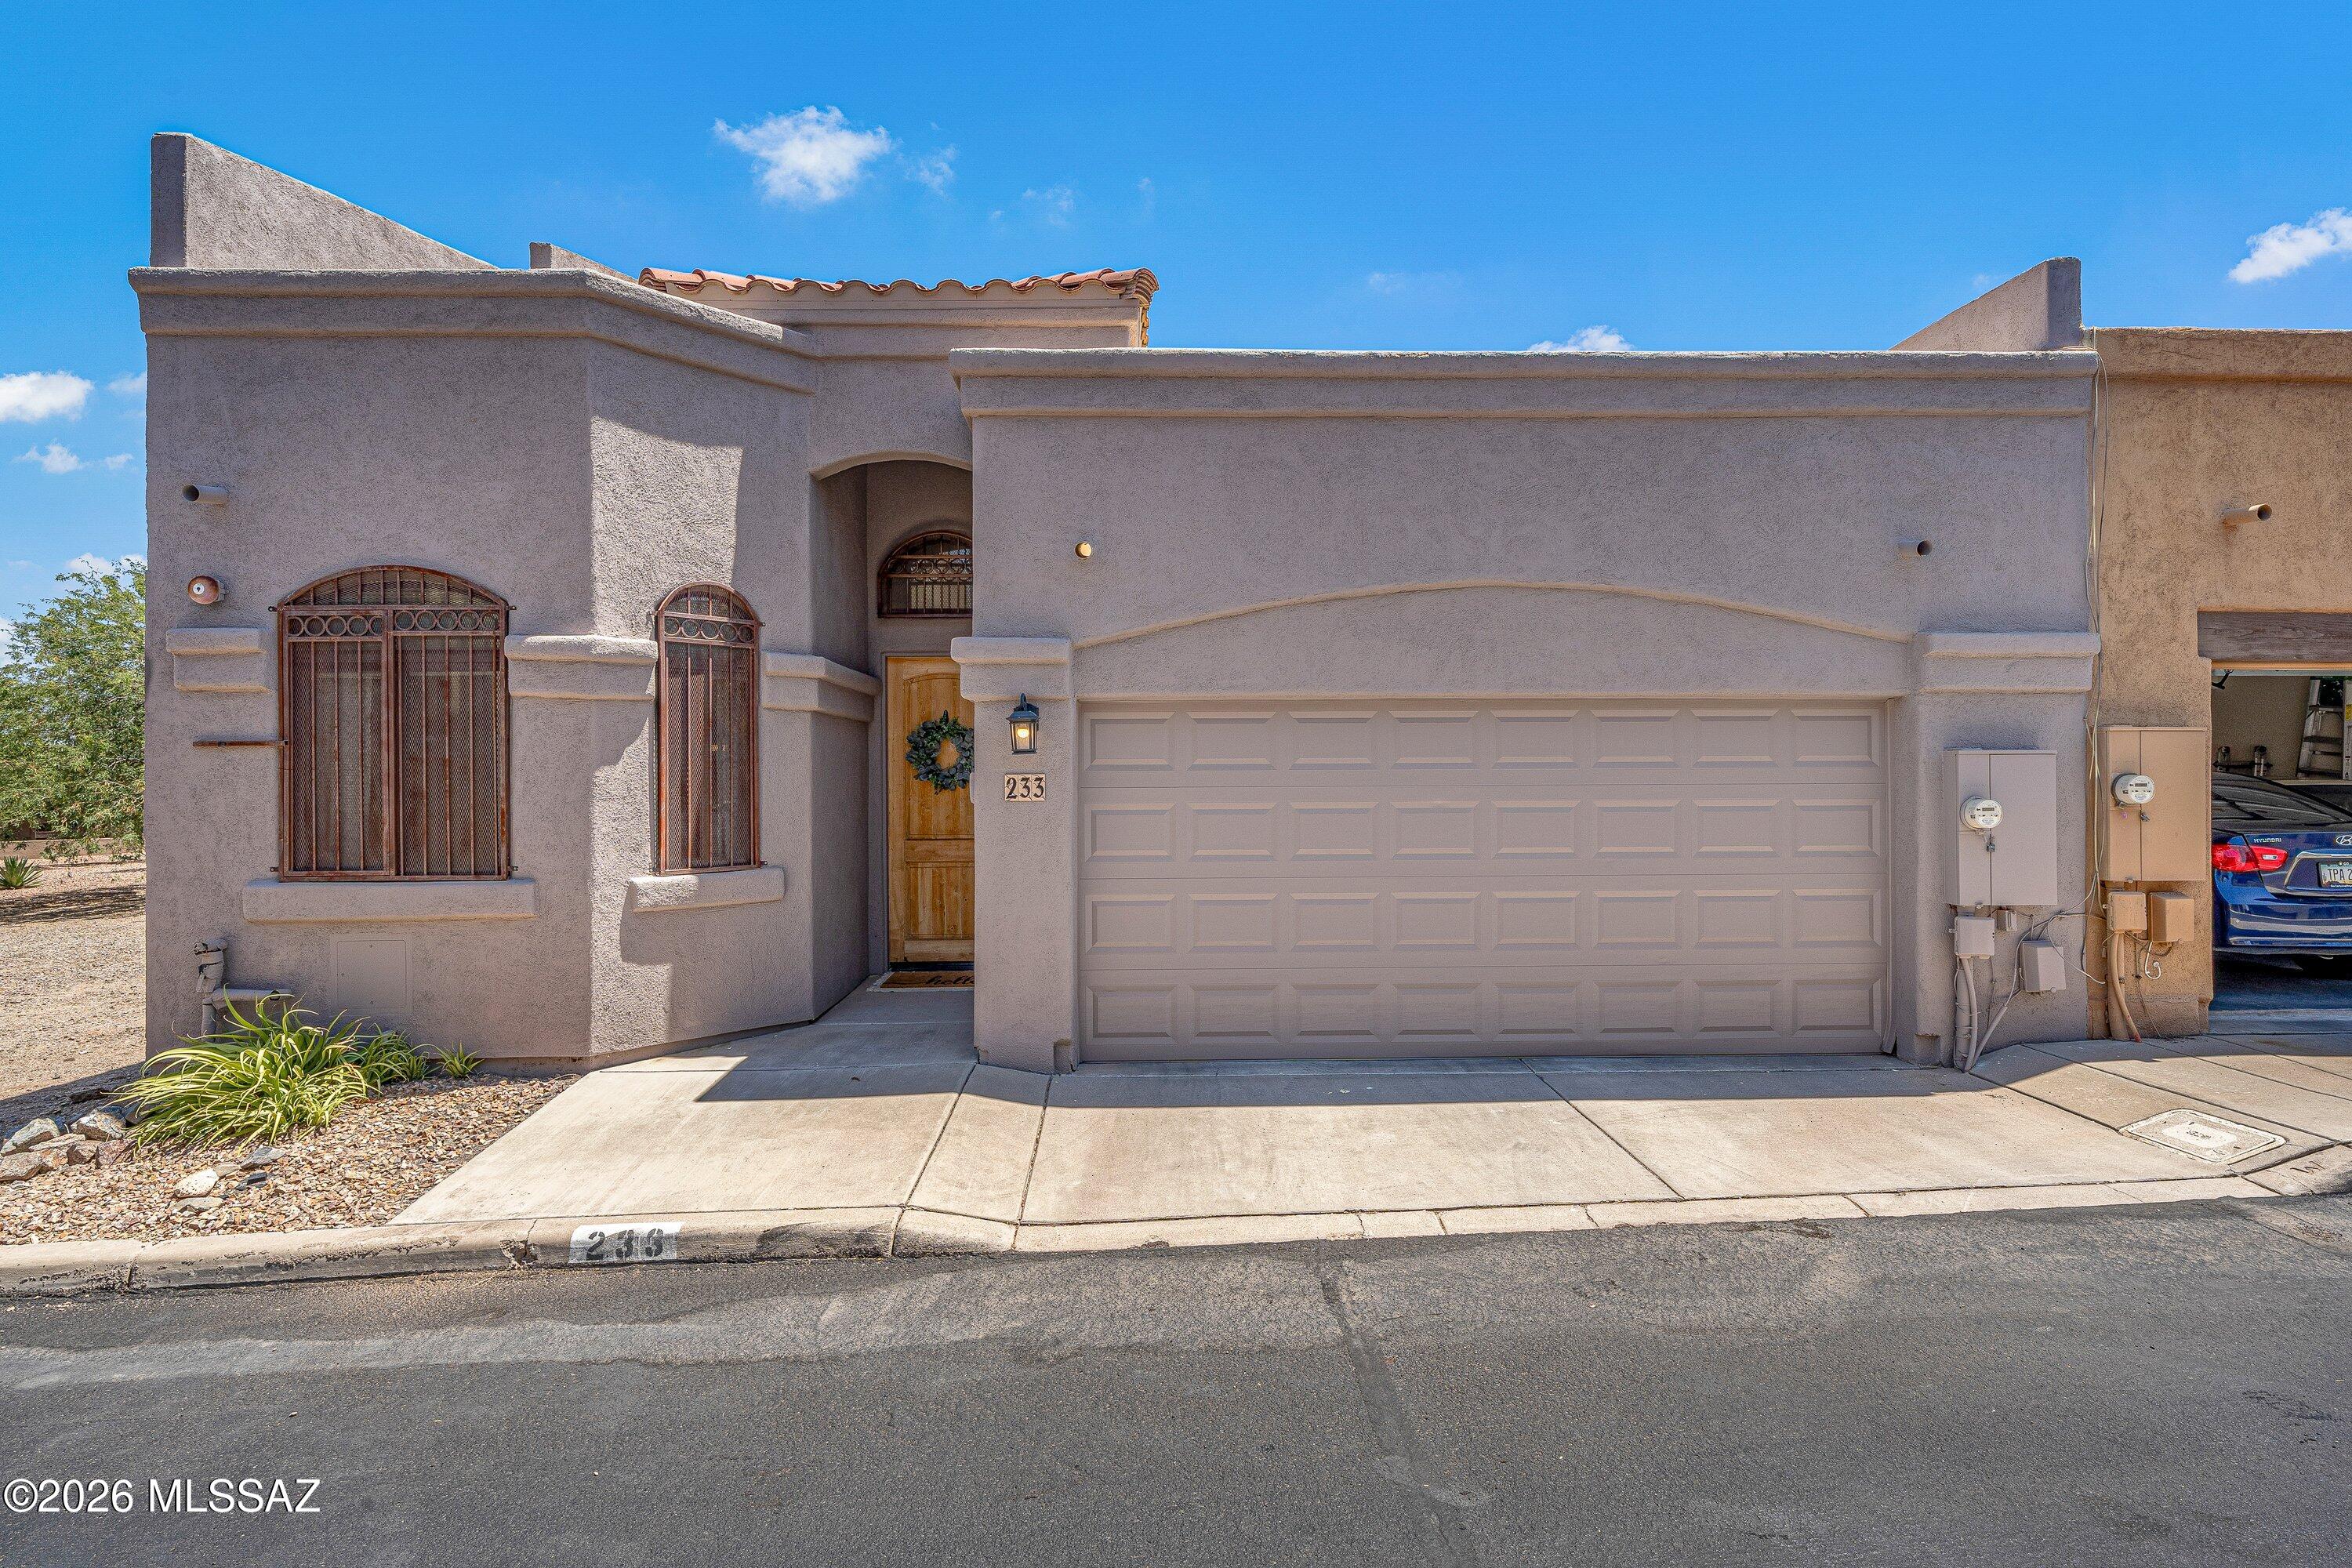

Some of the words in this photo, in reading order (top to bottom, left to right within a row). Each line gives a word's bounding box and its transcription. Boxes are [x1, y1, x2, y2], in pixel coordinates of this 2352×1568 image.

[1006, 777, 1044, 799] 233
[2328, 869, 2345, 880] TPA
[586, 1228, 664, 1260] 233
